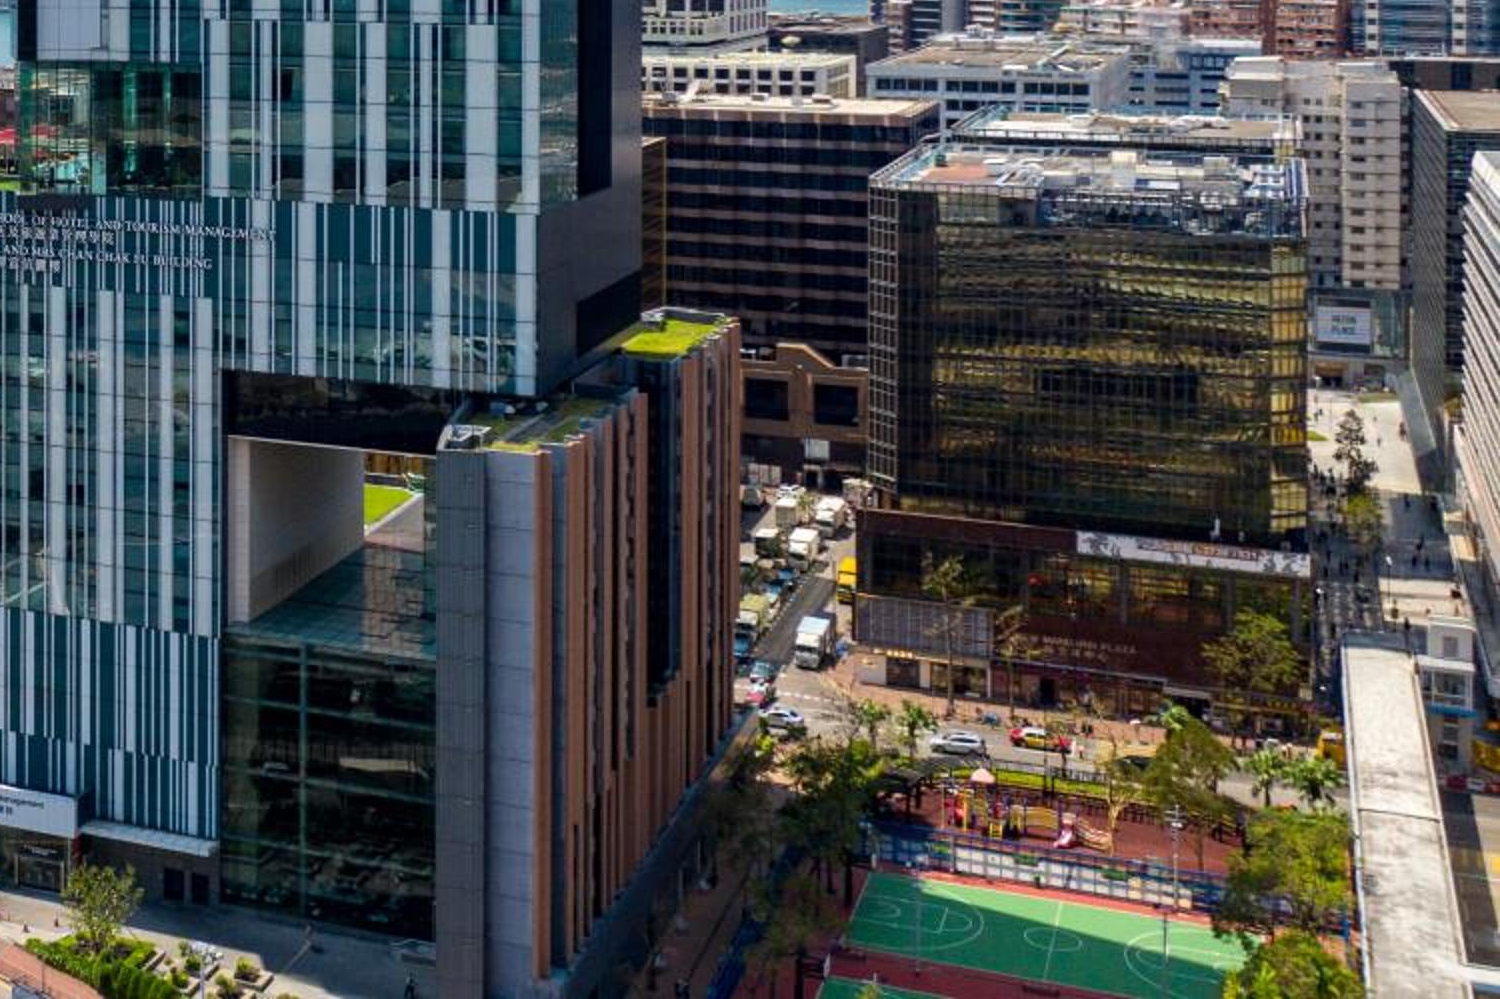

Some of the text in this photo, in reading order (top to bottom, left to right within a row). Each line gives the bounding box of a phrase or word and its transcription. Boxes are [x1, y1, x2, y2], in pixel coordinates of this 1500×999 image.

[32, 215, 45, 226] OF
[51, 216, 90, 228] HOTEL
[97, 220, 122, 231] AND
[124, 220, 181, 234] TOURISM
[185, 224, 276, 242] MANAGEMENT
[3, 244, 29, 256] AND
[59, 249, 94, 261] CHAN
[96, 251, 131, 263] CHAK
[152, 254, 213, 270] BUILDING
